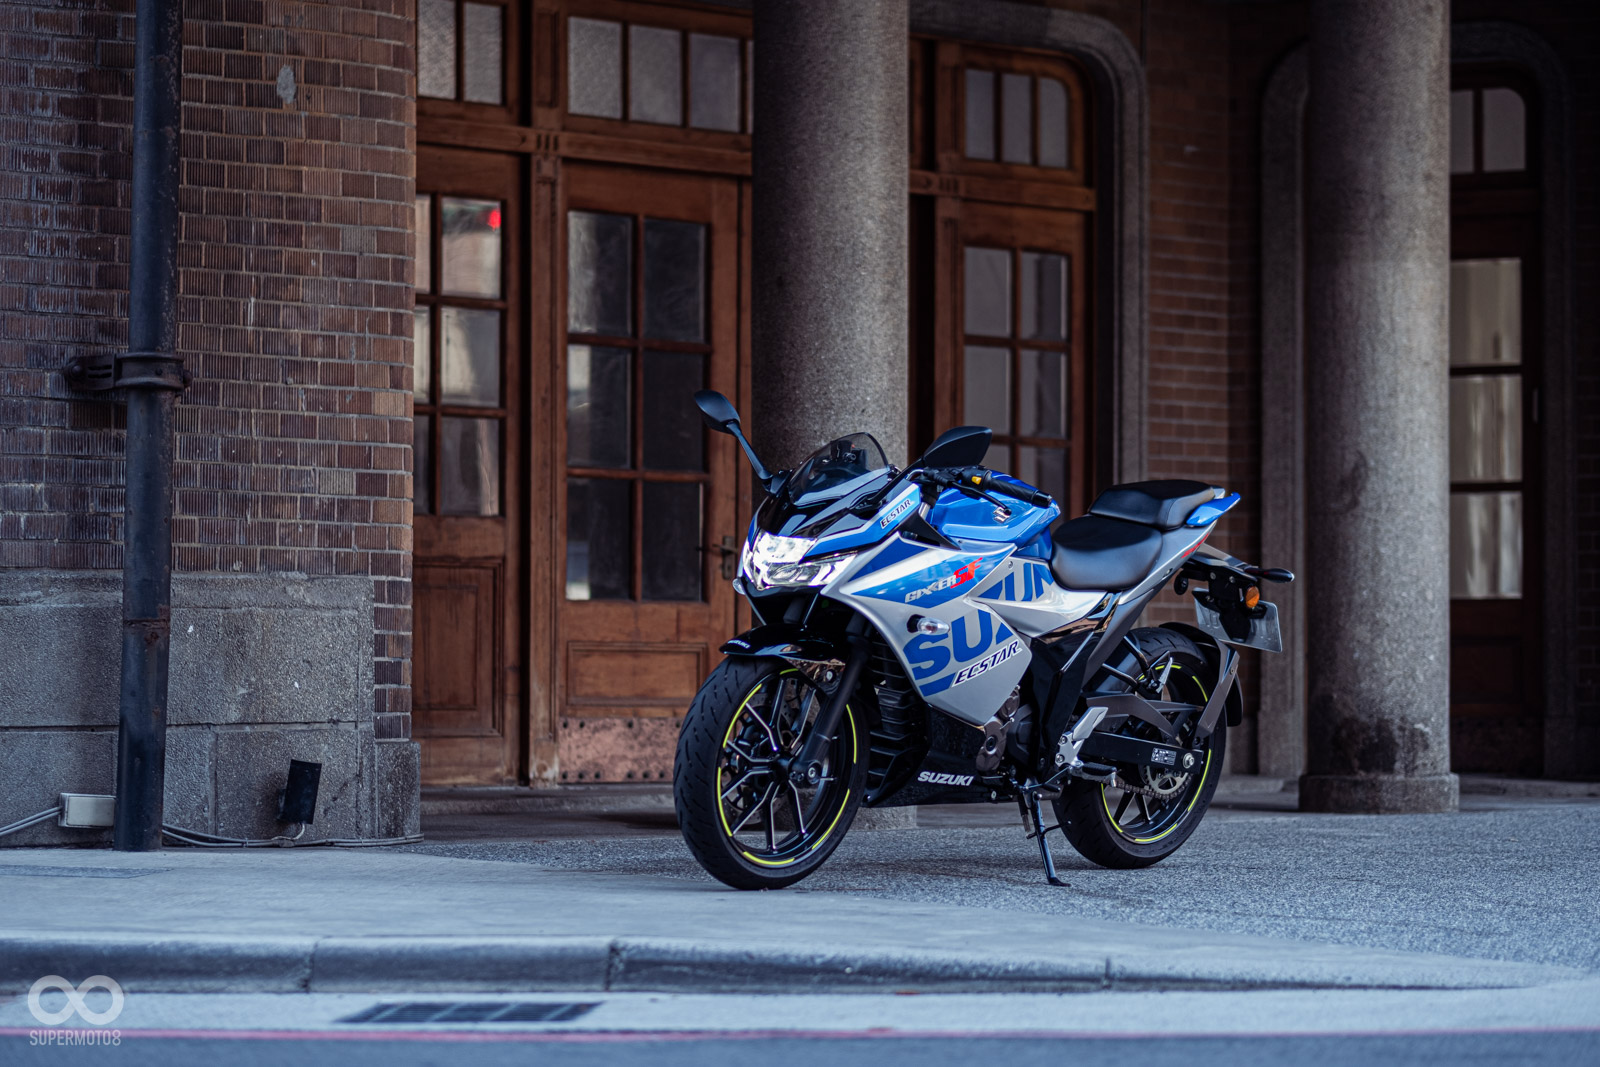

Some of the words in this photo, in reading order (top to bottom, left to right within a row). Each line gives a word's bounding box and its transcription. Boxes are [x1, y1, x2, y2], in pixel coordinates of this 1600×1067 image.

[880, 498, 914, 529] ECSTAR
[952, 640, 1022, 687] ECSTAR
[917, 771, 974, 786] SUZUKI
